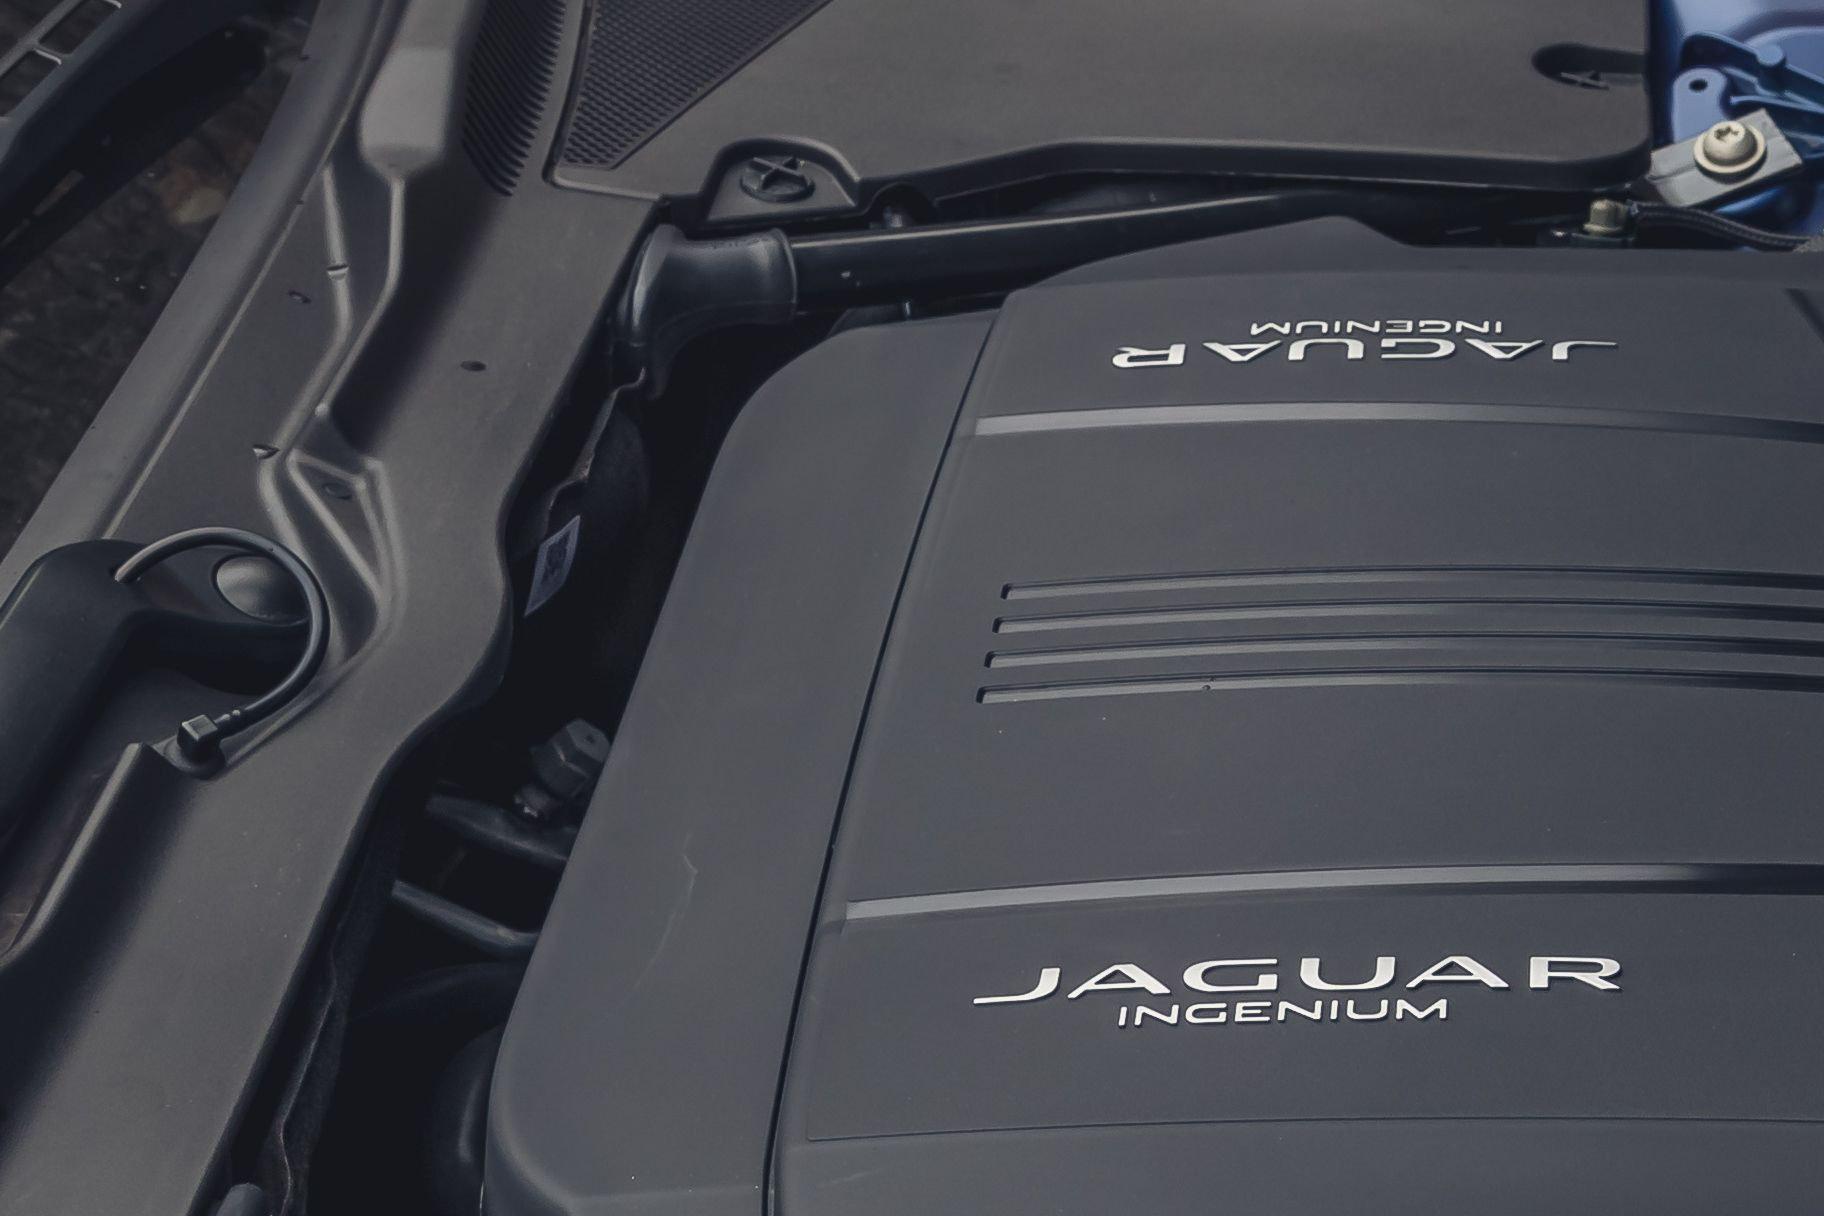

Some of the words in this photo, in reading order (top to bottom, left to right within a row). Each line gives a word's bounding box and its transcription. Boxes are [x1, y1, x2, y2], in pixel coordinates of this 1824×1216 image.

[1251, 320, 1502, 337] INGENIUM
[1112, 338, 1617, 368] JAGUAR
[973, 956, 1624, 1004] JAGUAR
[1117, 999, 1449, 1027] INGENIUM
